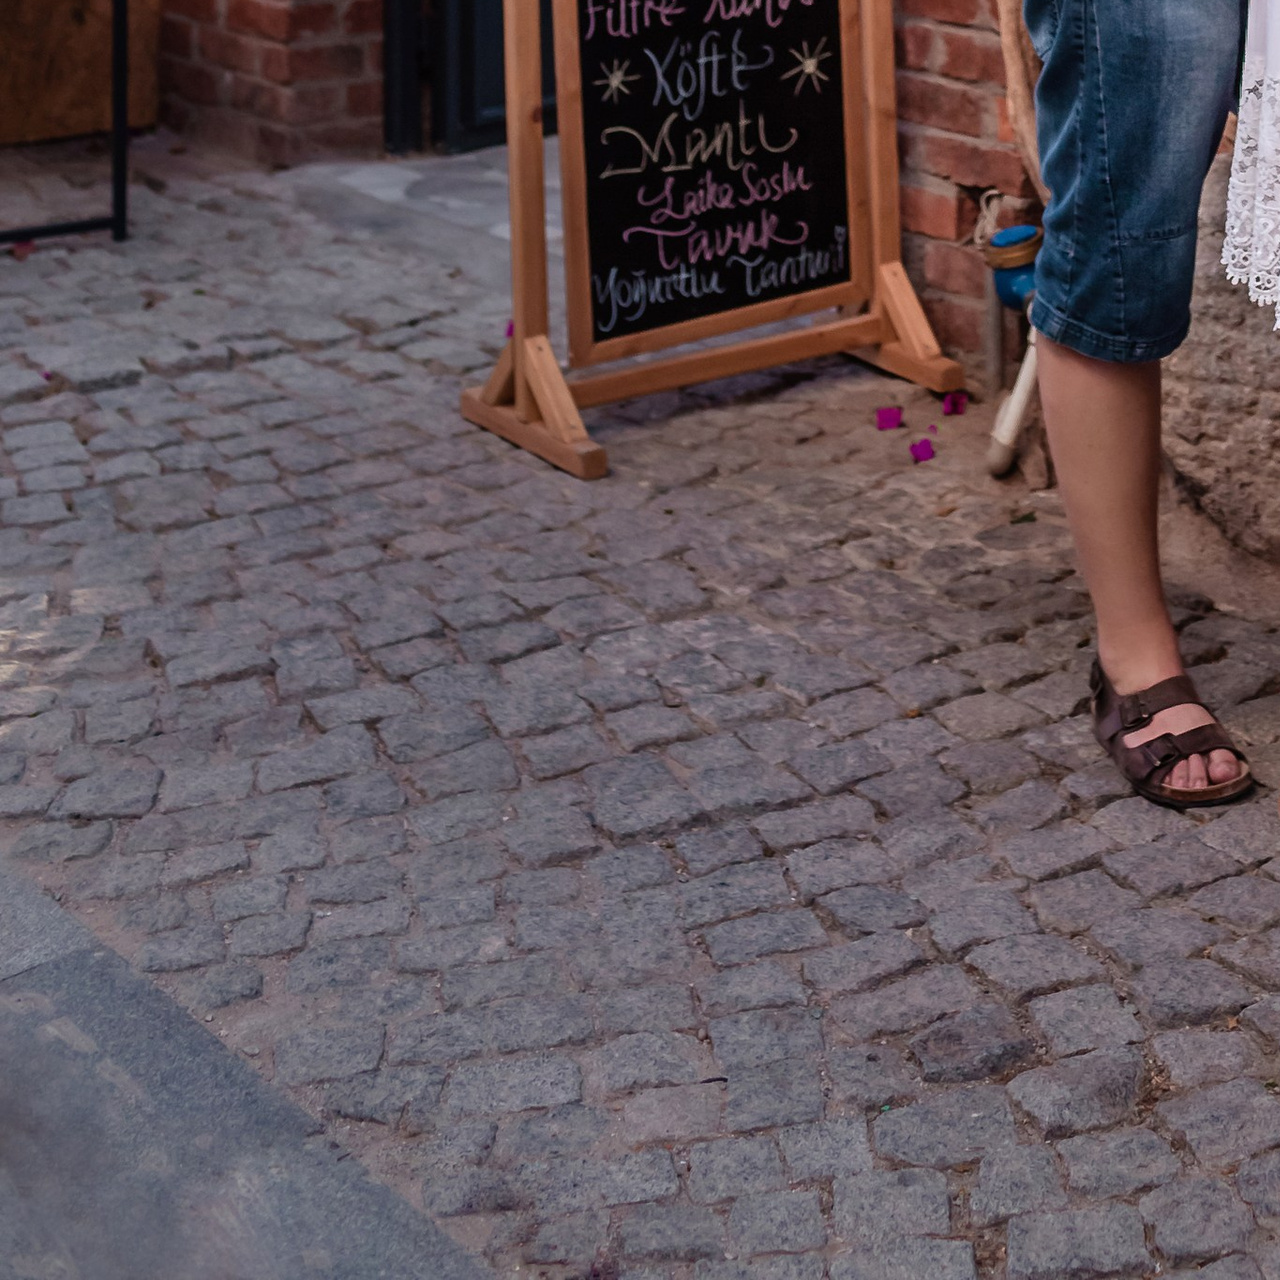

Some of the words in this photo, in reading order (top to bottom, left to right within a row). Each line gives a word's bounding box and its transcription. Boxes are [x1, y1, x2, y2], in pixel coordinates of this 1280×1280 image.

[642, 27, 775, 121] Köfte
[622, 207, 810, 271] Tavuk
[592, 263, 727, 333] Yoğurtlu
